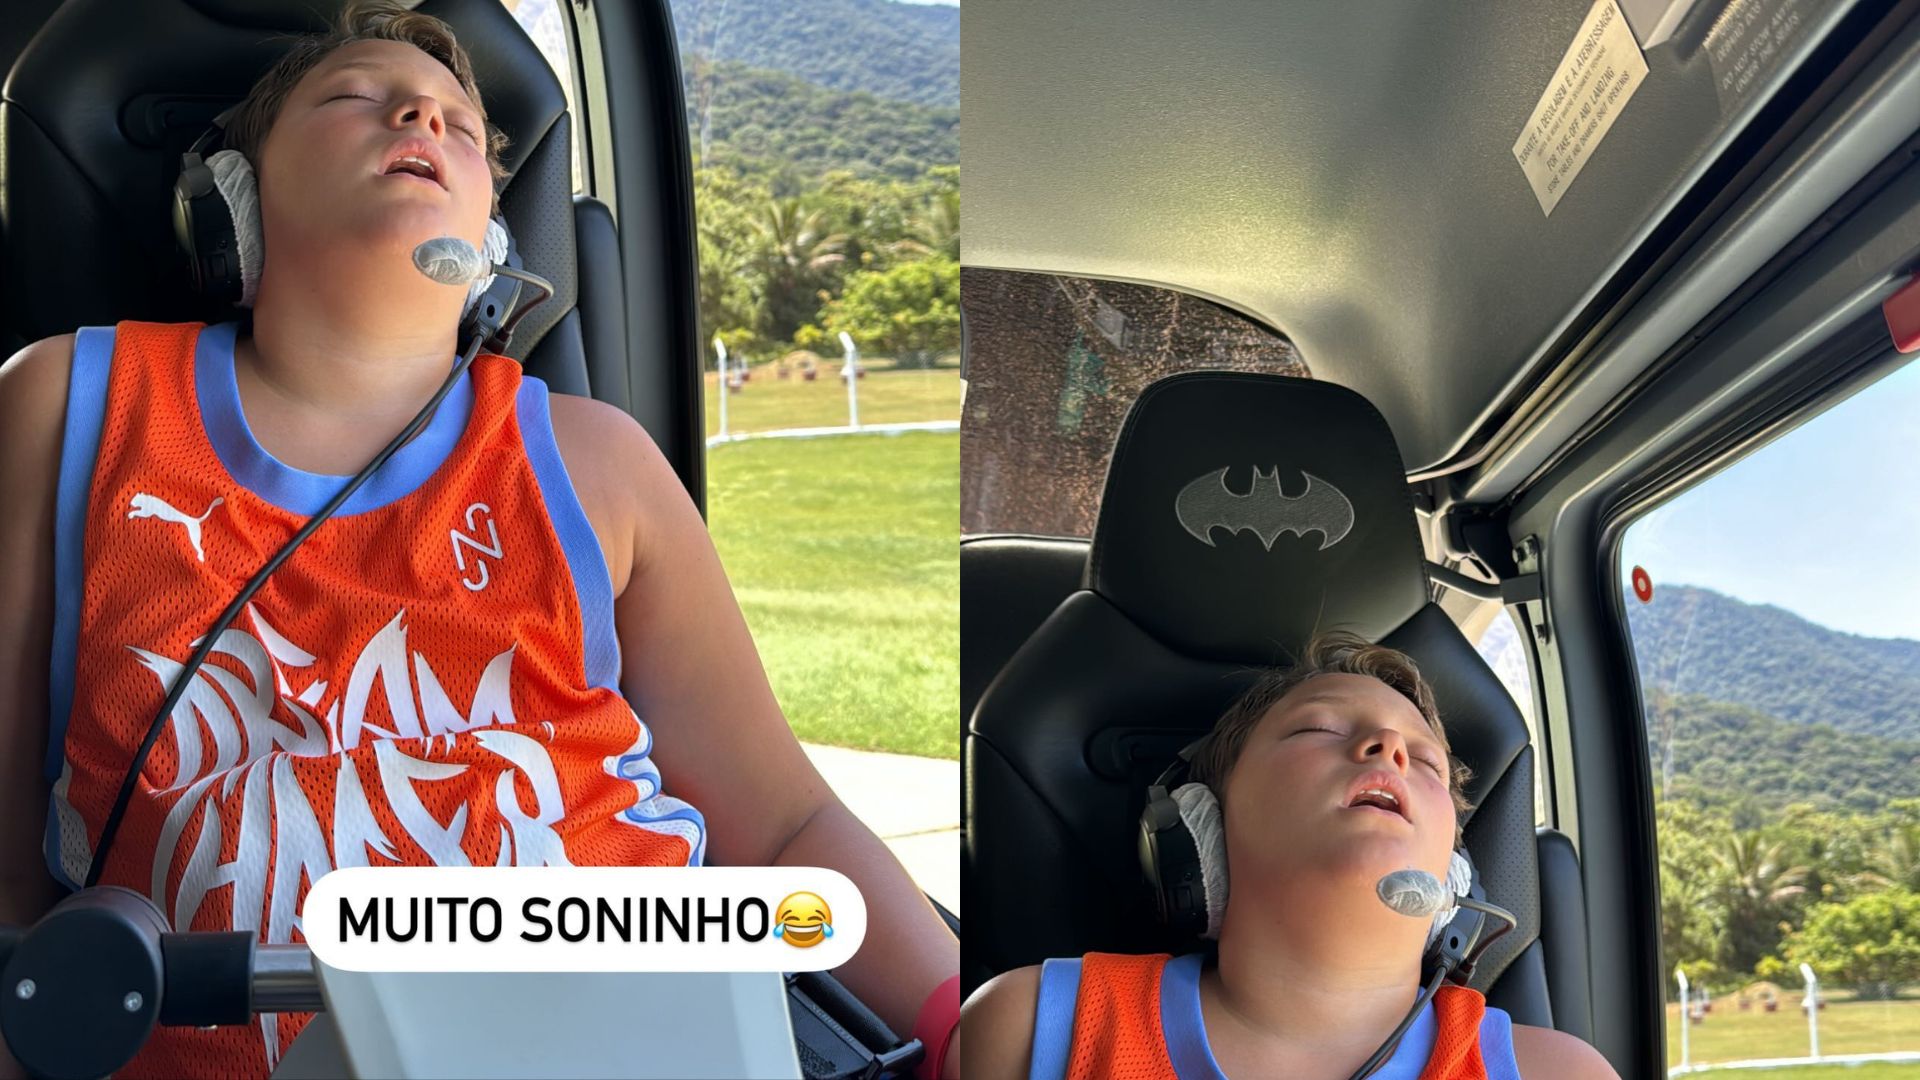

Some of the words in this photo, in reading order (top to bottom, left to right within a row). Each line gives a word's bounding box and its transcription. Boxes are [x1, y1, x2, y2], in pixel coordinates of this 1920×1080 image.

[1546, 153, 1558, 171] FOR
[1556, 118, 1581, 156] TAKE-OFF
[1579, 102, 1592, 123] AND
[1590, 66, 1615, 105] LANDING
